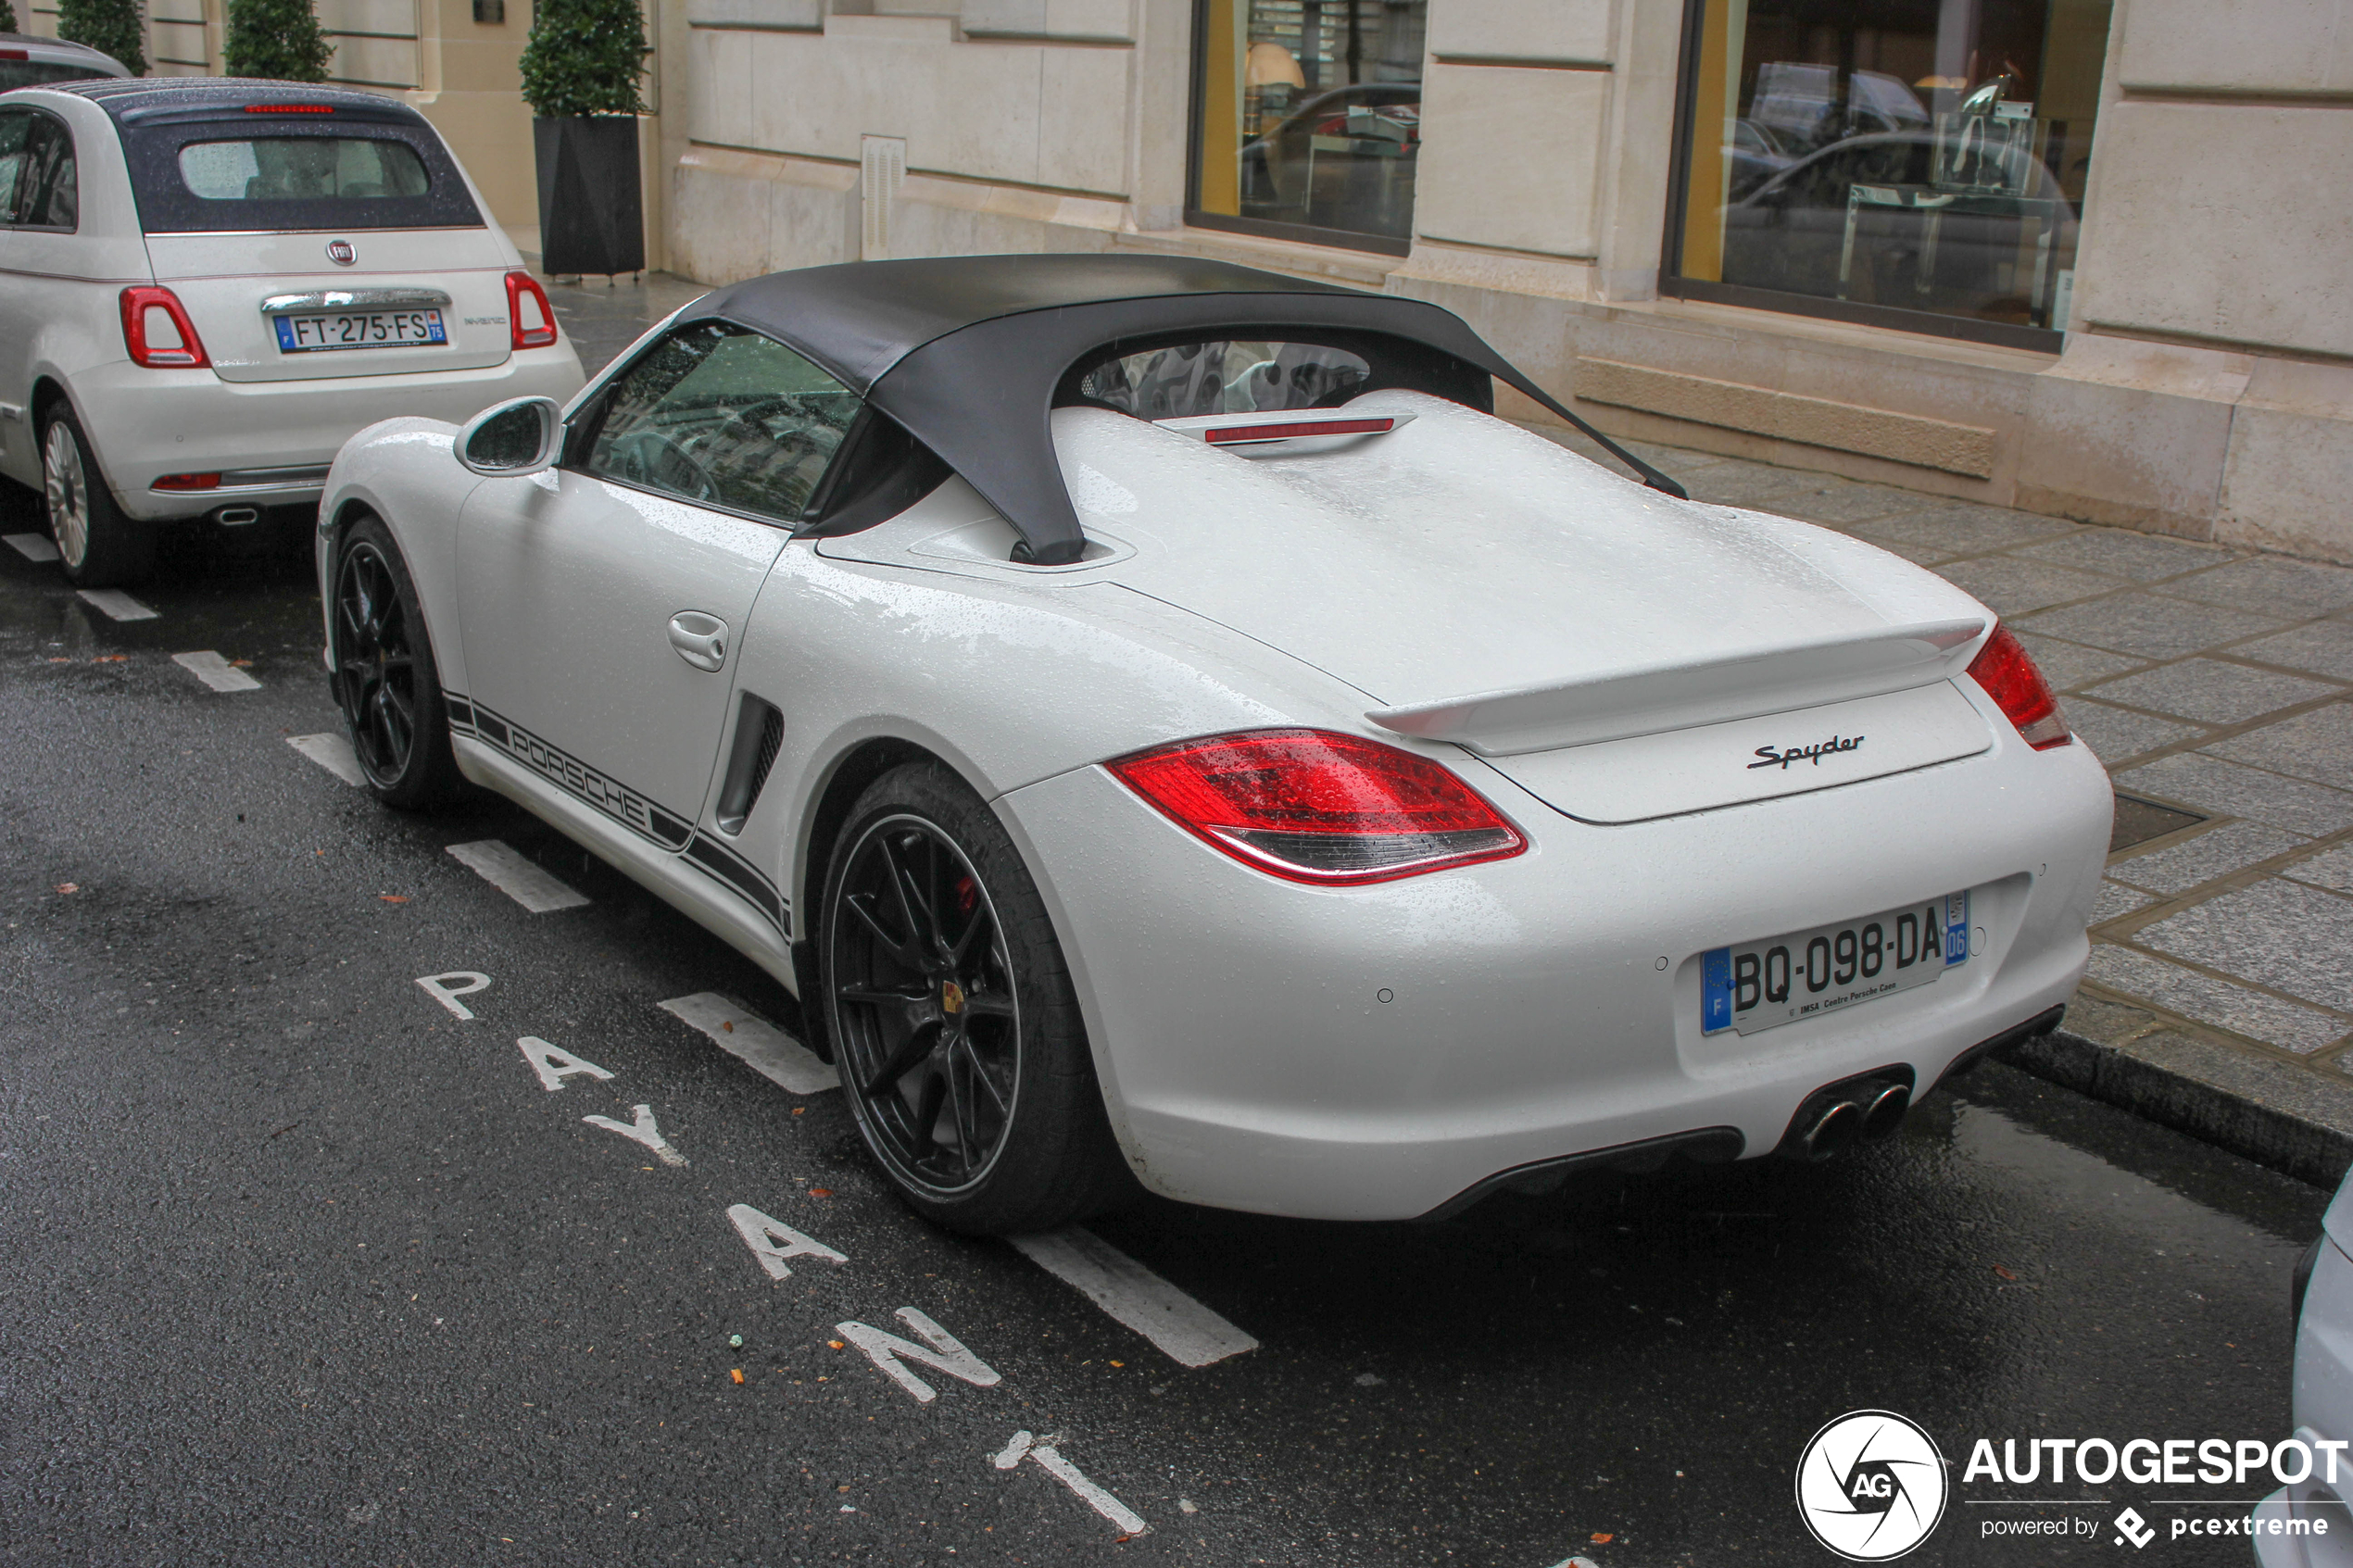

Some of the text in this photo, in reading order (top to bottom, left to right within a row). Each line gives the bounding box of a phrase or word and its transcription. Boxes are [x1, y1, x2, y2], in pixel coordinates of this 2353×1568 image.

[283, 335, 289, 344] F
[294, 314, 427, 345] FT-275-FS
[430, 326, 443, 338] 75
[1746, 734, 1865, 770] Spyder
[511, 729, 647, 827] PORSCHE
[1947, 929, 1965, 958] 06
[1734, 906, 1942, 1013] BQ-098-DA
[1713, 997, 1722, 1017] F
[1800, 982, 1896, 1015] IMSA Centre Porsche Caen
